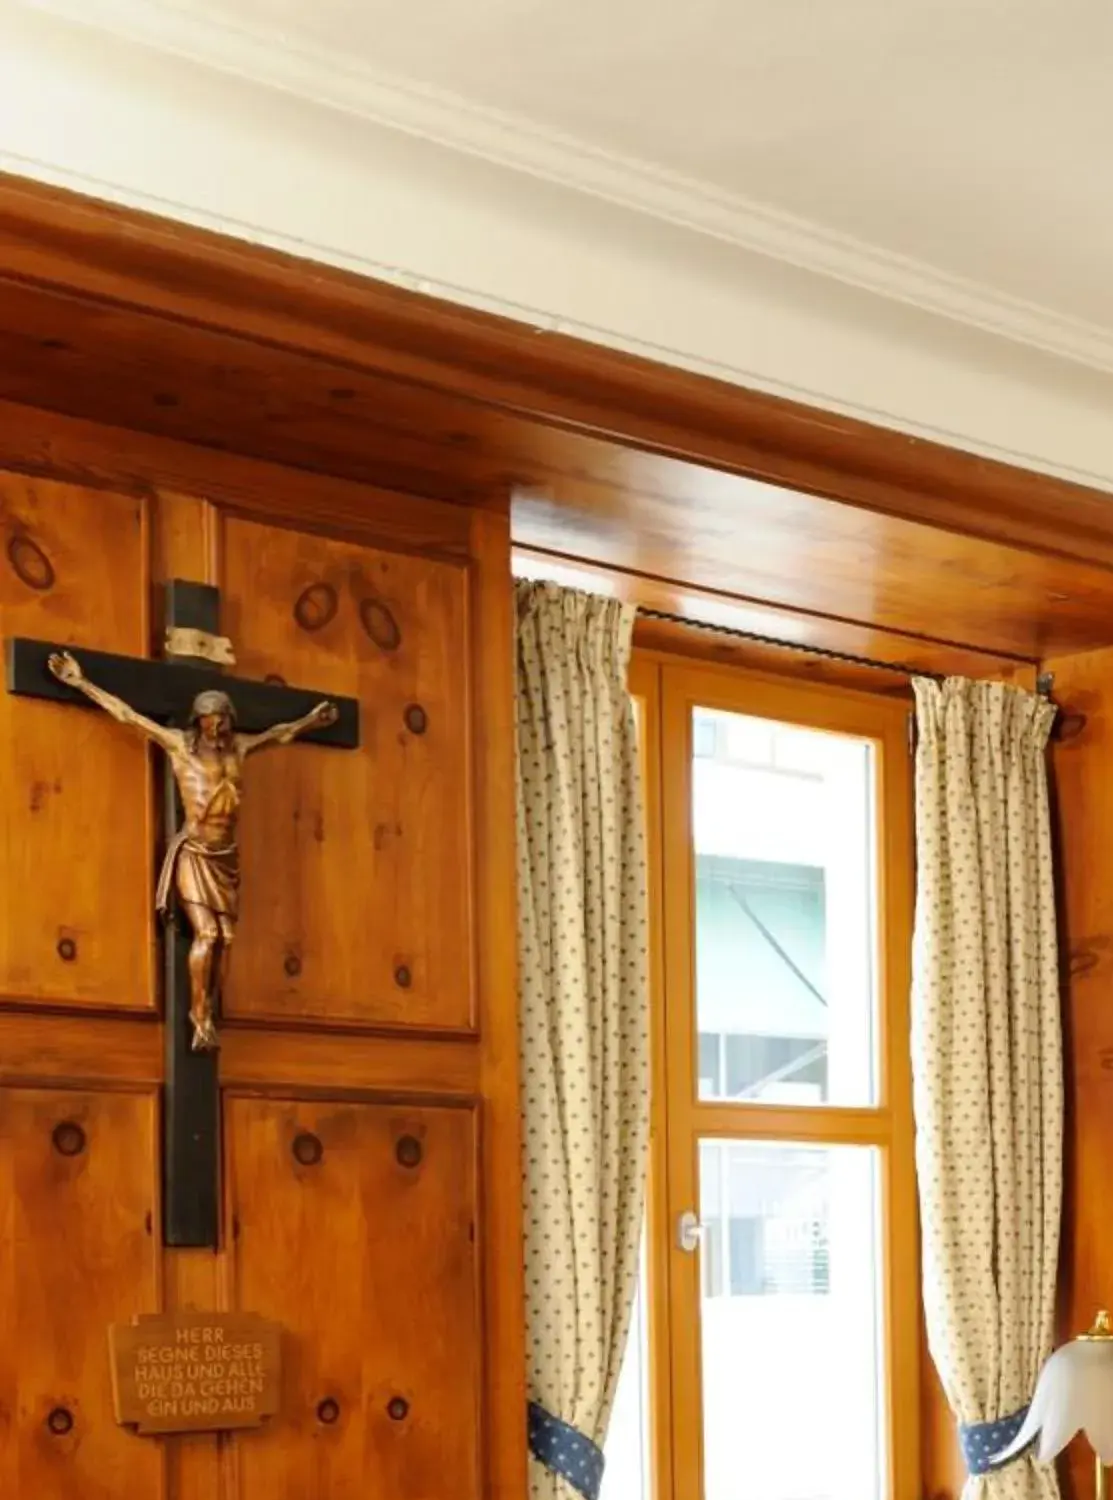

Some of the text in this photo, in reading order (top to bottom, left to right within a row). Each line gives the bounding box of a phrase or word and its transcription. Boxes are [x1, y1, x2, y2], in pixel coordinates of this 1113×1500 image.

[176, 1327, 224, 1343] HERR
[138, 1344, 262, 1364] SEGNE DIESES
[134, 1360, 266, 1381] HAUS UND ALLE
[139, 1379, 263, 1399] DIE DA GEHEN
[147, 1396, 256, 1416] EIN UND AUS
